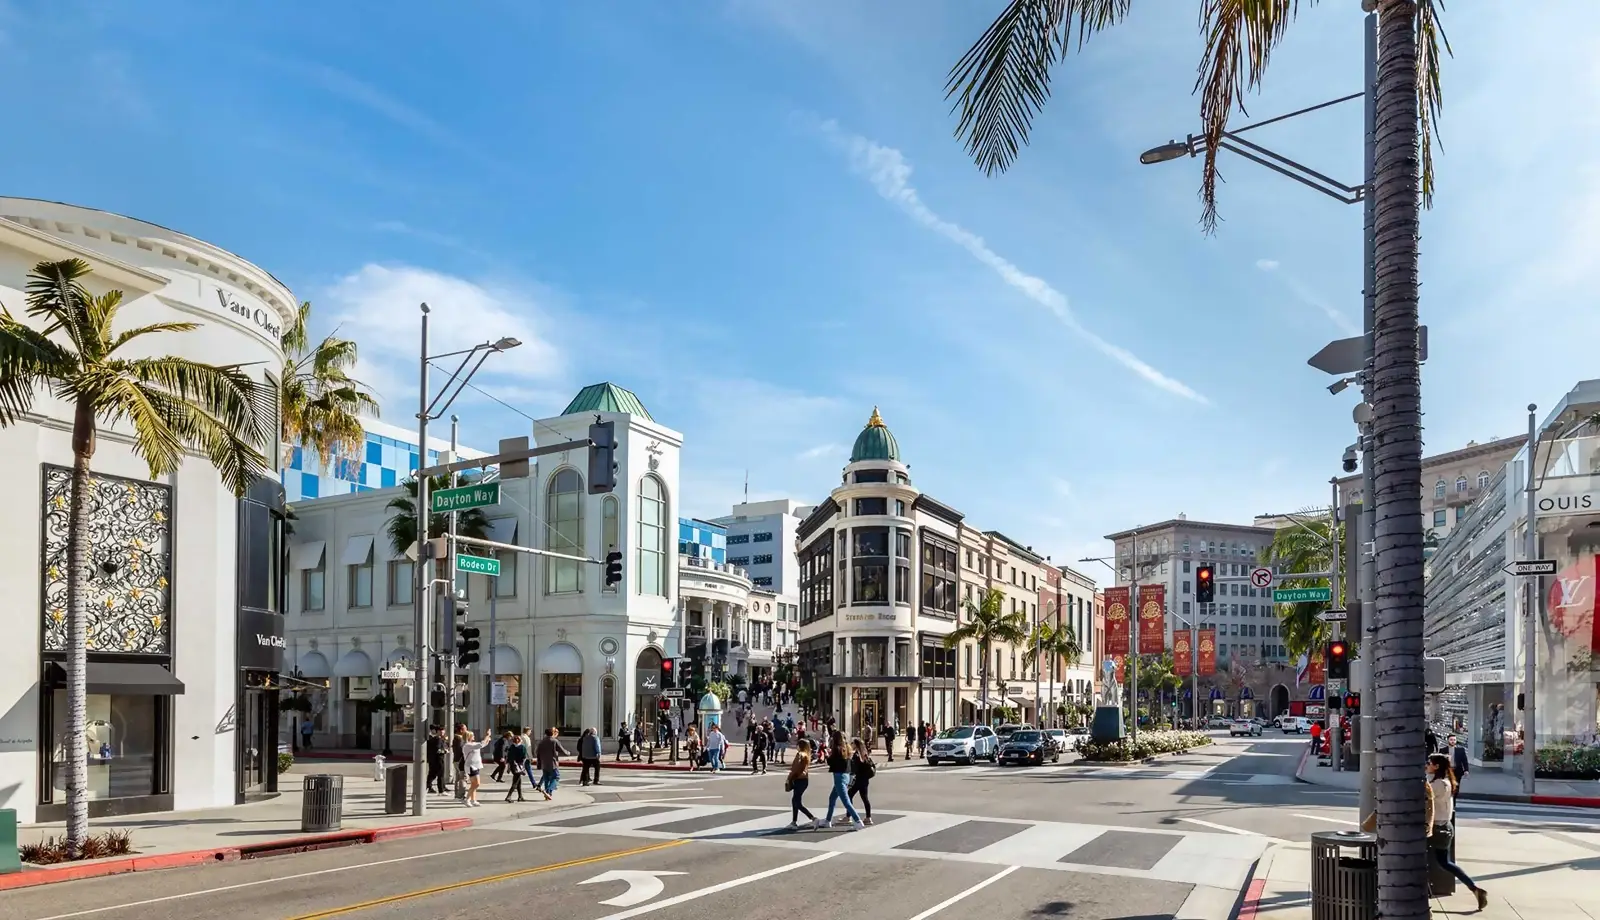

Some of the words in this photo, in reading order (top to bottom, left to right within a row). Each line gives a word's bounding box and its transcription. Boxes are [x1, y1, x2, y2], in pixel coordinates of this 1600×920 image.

[216, 288, 250, 319] Van
[437, 493, 471, 508] Dayton
[474, 490, 494, 503] Way
[1538, 494, 1592, 511] OUIS
[460, 558, 485, 570] Rodeo
[487, 562, 496, 571] Dr
[1276, 592, 1307, 600] Dayton
[1309, 591, 1326, 599] Way
[256, 634, 270, 646] Van
